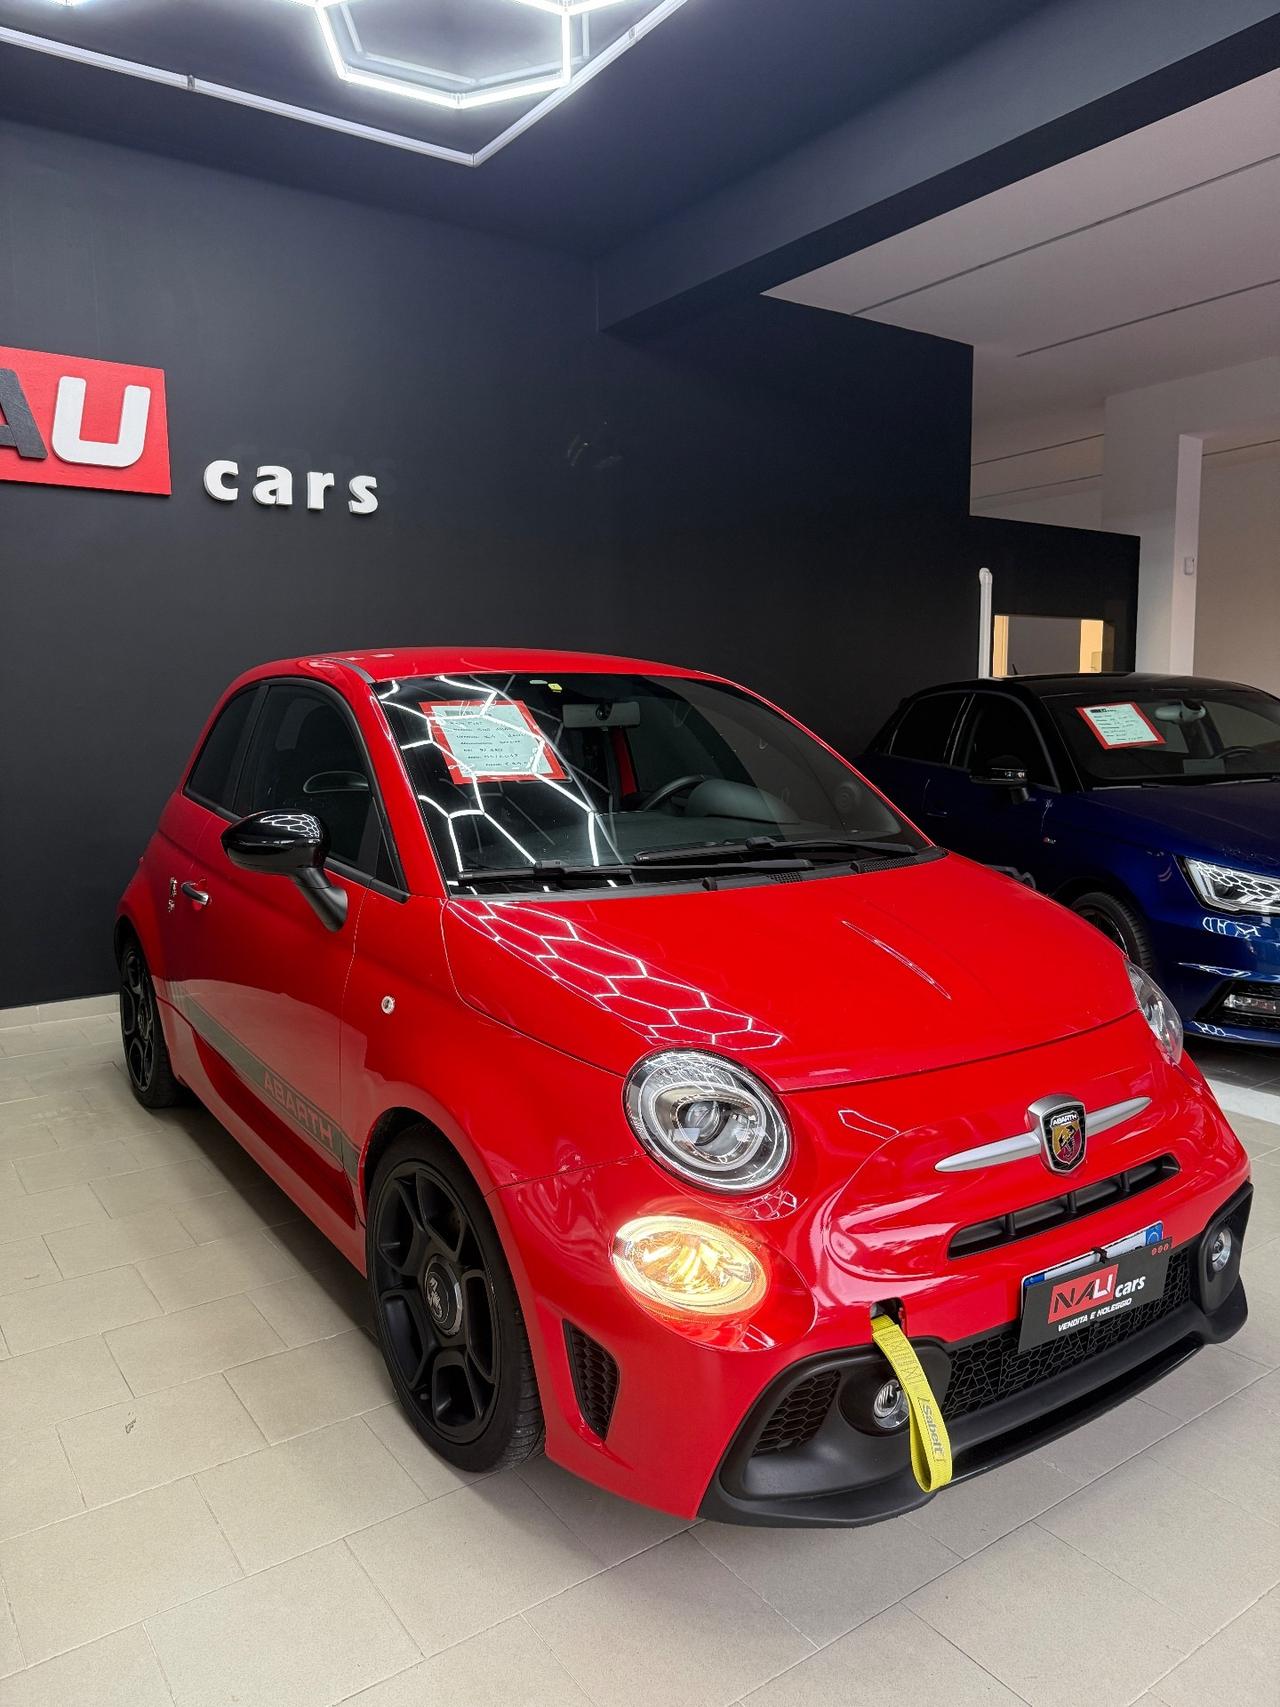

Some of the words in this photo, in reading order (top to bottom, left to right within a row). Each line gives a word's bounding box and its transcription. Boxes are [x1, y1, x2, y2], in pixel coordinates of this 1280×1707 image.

[203, 459, 379, 515] cars
[263, 1071, 333, 1149] ABARTH
[1052, 1114, 1078, 1126] ABARTH
[1115, 1275, 1146, 1298] cars
[1058, 1314, 1088, 1332] VENDITA
[1089, 1310, 1097, 1320] E
[1097, 1297, 1132, 1318] NOLEGGIO
[923, 1404, 944, 1455] Sabelt
